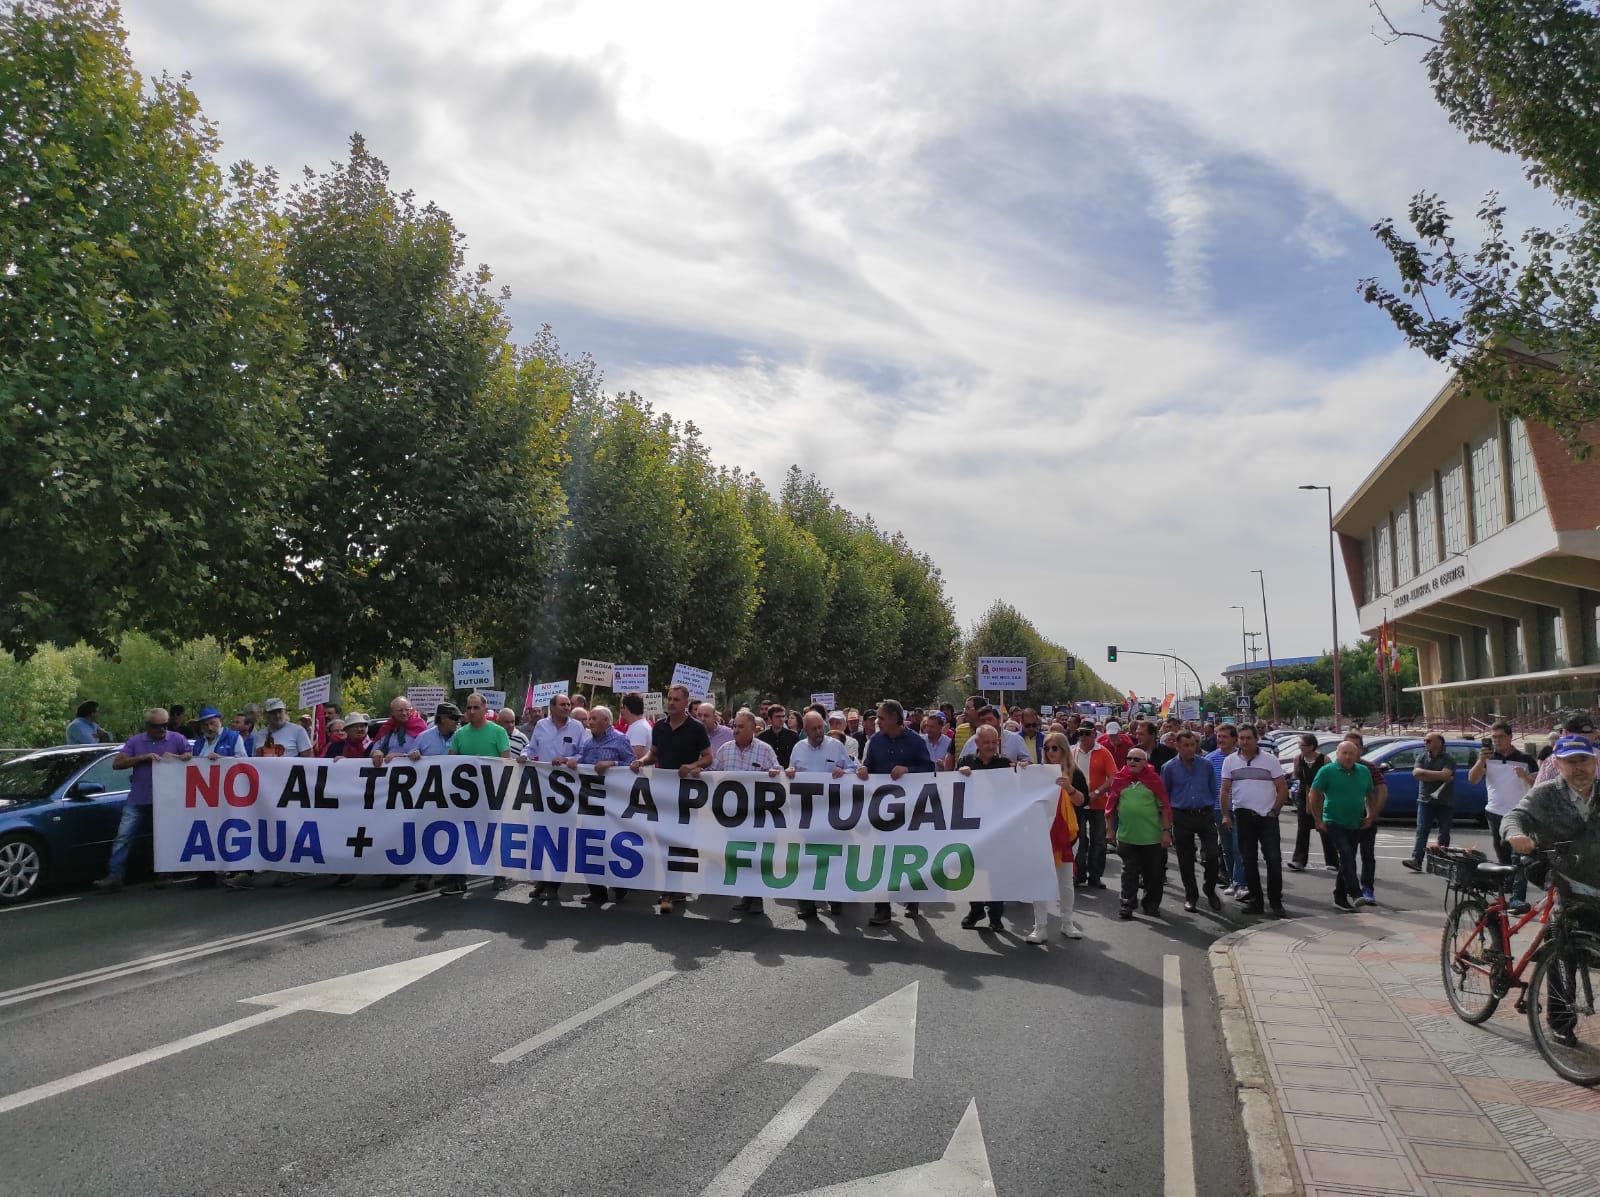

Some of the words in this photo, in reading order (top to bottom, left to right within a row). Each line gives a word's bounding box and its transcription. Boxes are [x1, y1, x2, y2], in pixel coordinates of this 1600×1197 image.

[458, 678, 490, 686] FUTURO
[185, 764, 260, 809] NO
[276, 765, 339, 809] AL
[359, 765, 606, 817] TRASVASE
[621, 777, 659, 822] A
[678, 778, 981, 832] PORTUGAL
[179, 818, 327, 864] AGUA
[346, 826, 374, 862] +
[385, 820, 645, 879] JOVENES
[723, 841, 976, 893] FUTURO
